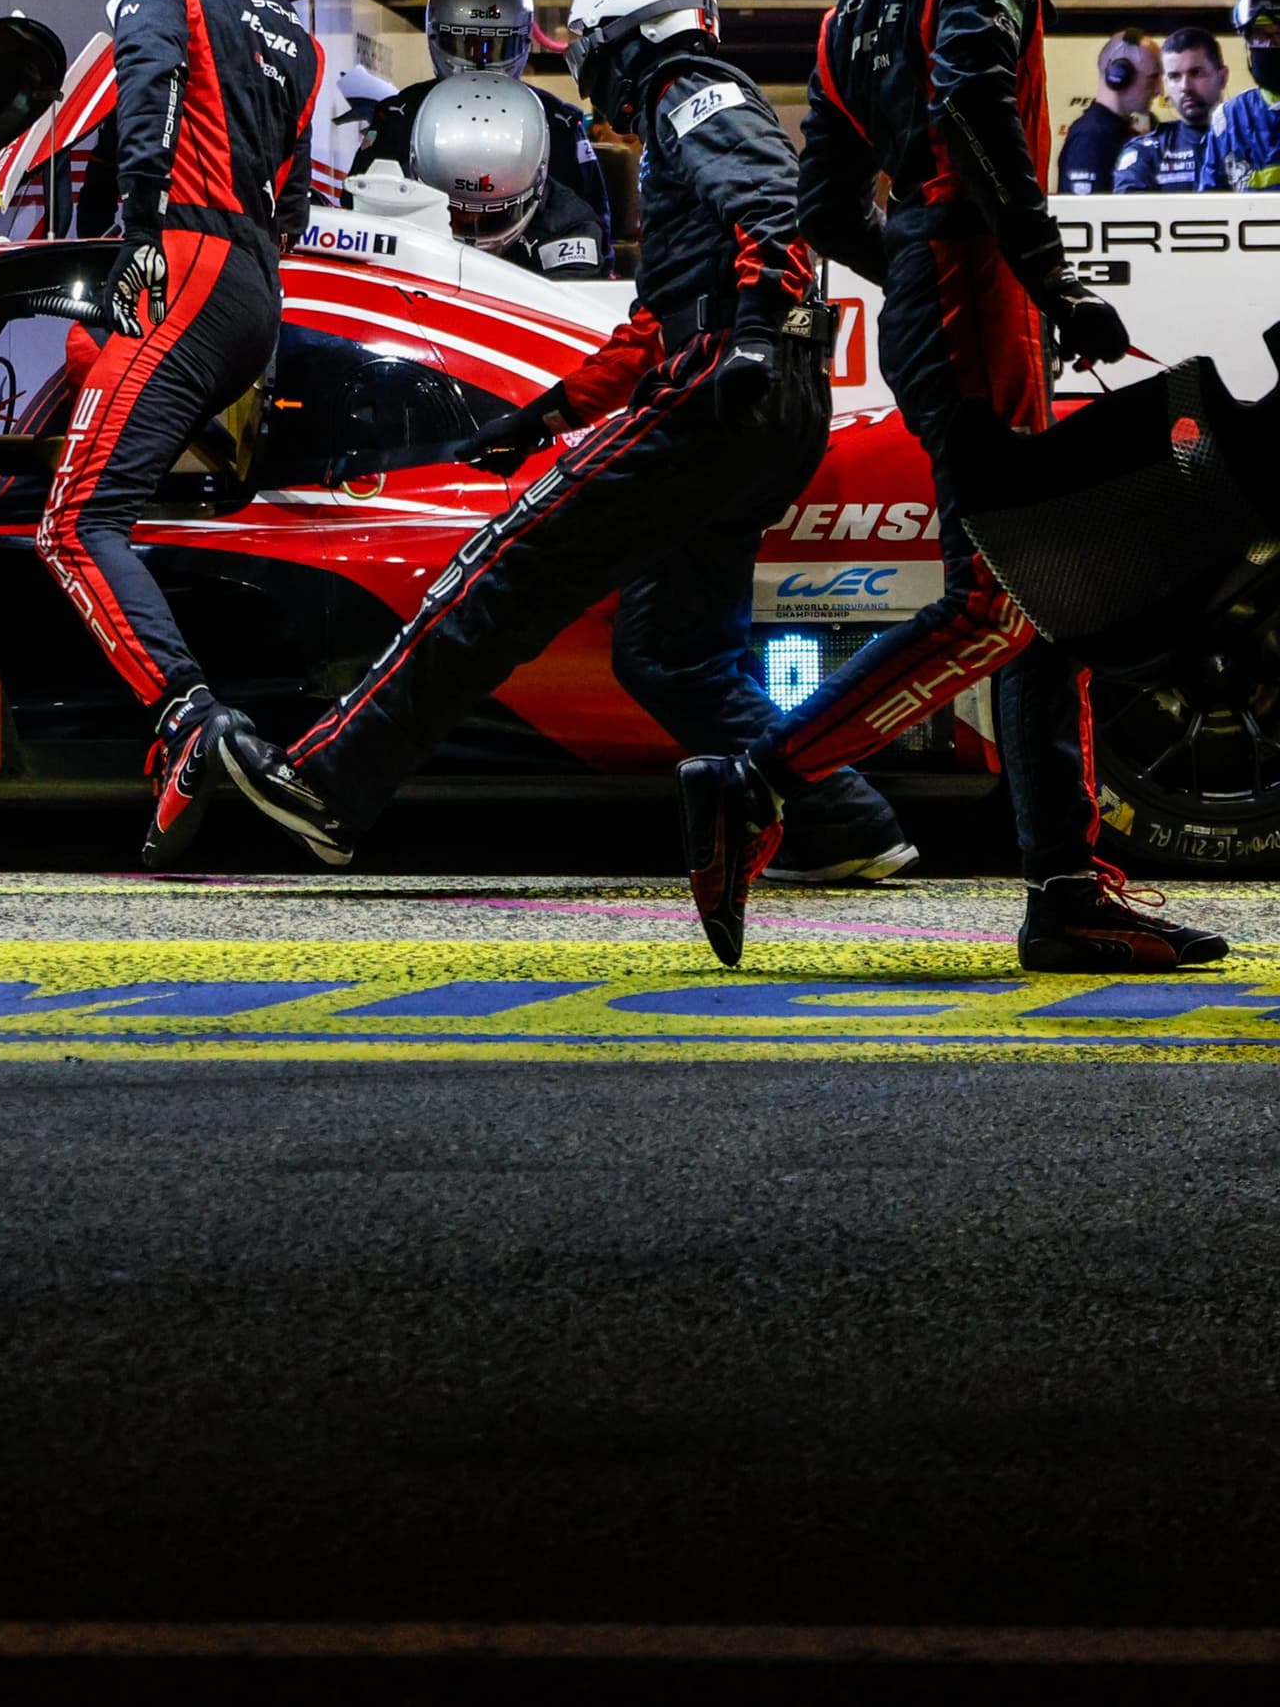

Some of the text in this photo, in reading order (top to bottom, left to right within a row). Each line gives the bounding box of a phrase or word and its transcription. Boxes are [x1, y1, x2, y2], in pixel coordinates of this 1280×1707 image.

[470, 4, 501, 20] Stilo
[438, 23, 529, 37] PORSCHE
[455, 175, 495, 193] Stilo
[450, 196, 523, 214] RSCH
[302, 226, 368, 252] Mobil
[339, 464, 566, 708] SCHE
[776, 567, 898, 598] WEC
[775, 611, 851, 619] CHAMPIONSHIP
[776, 602, 890, 611] FIA WORLD ENDURANCE
